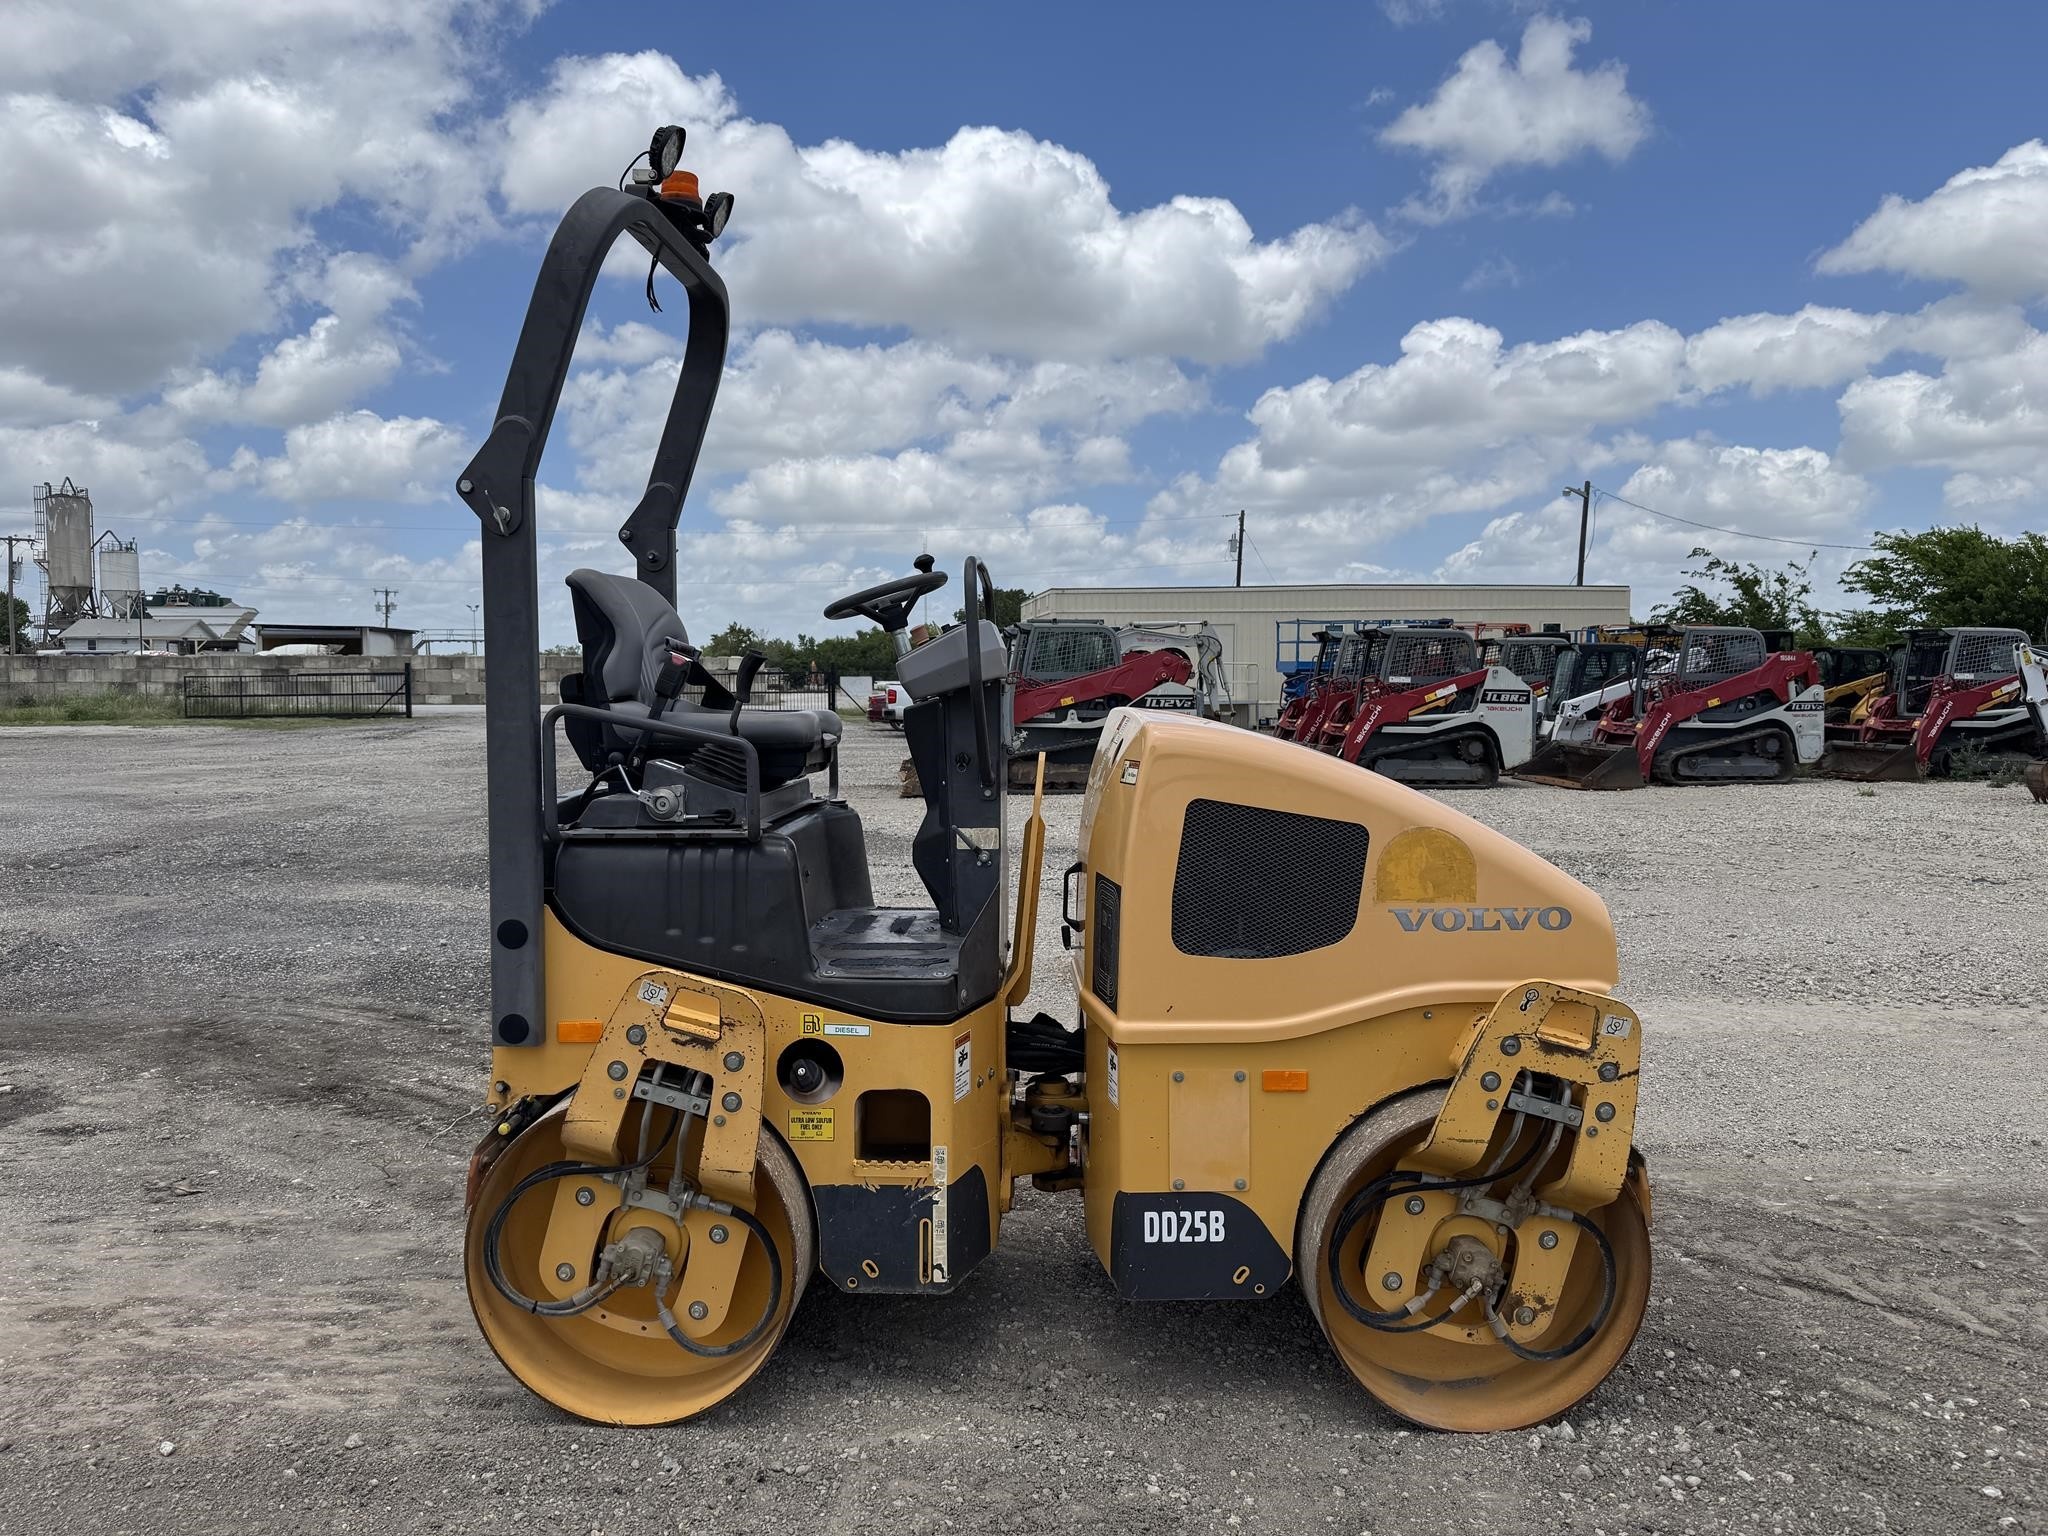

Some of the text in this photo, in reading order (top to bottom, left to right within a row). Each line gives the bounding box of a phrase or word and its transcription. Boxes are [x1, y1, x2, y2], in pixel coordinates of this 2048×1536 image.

[1354, 705, 1382, 743] TAKEUCHI
[1646, 712, 1671, 750] TAKEUCHI
[1928, 701, 1953, 738] TAKEUCHI
[1388, 907, 1572, 932] VOLVO
[1144, 1211, 1225, 1243] DD25B
